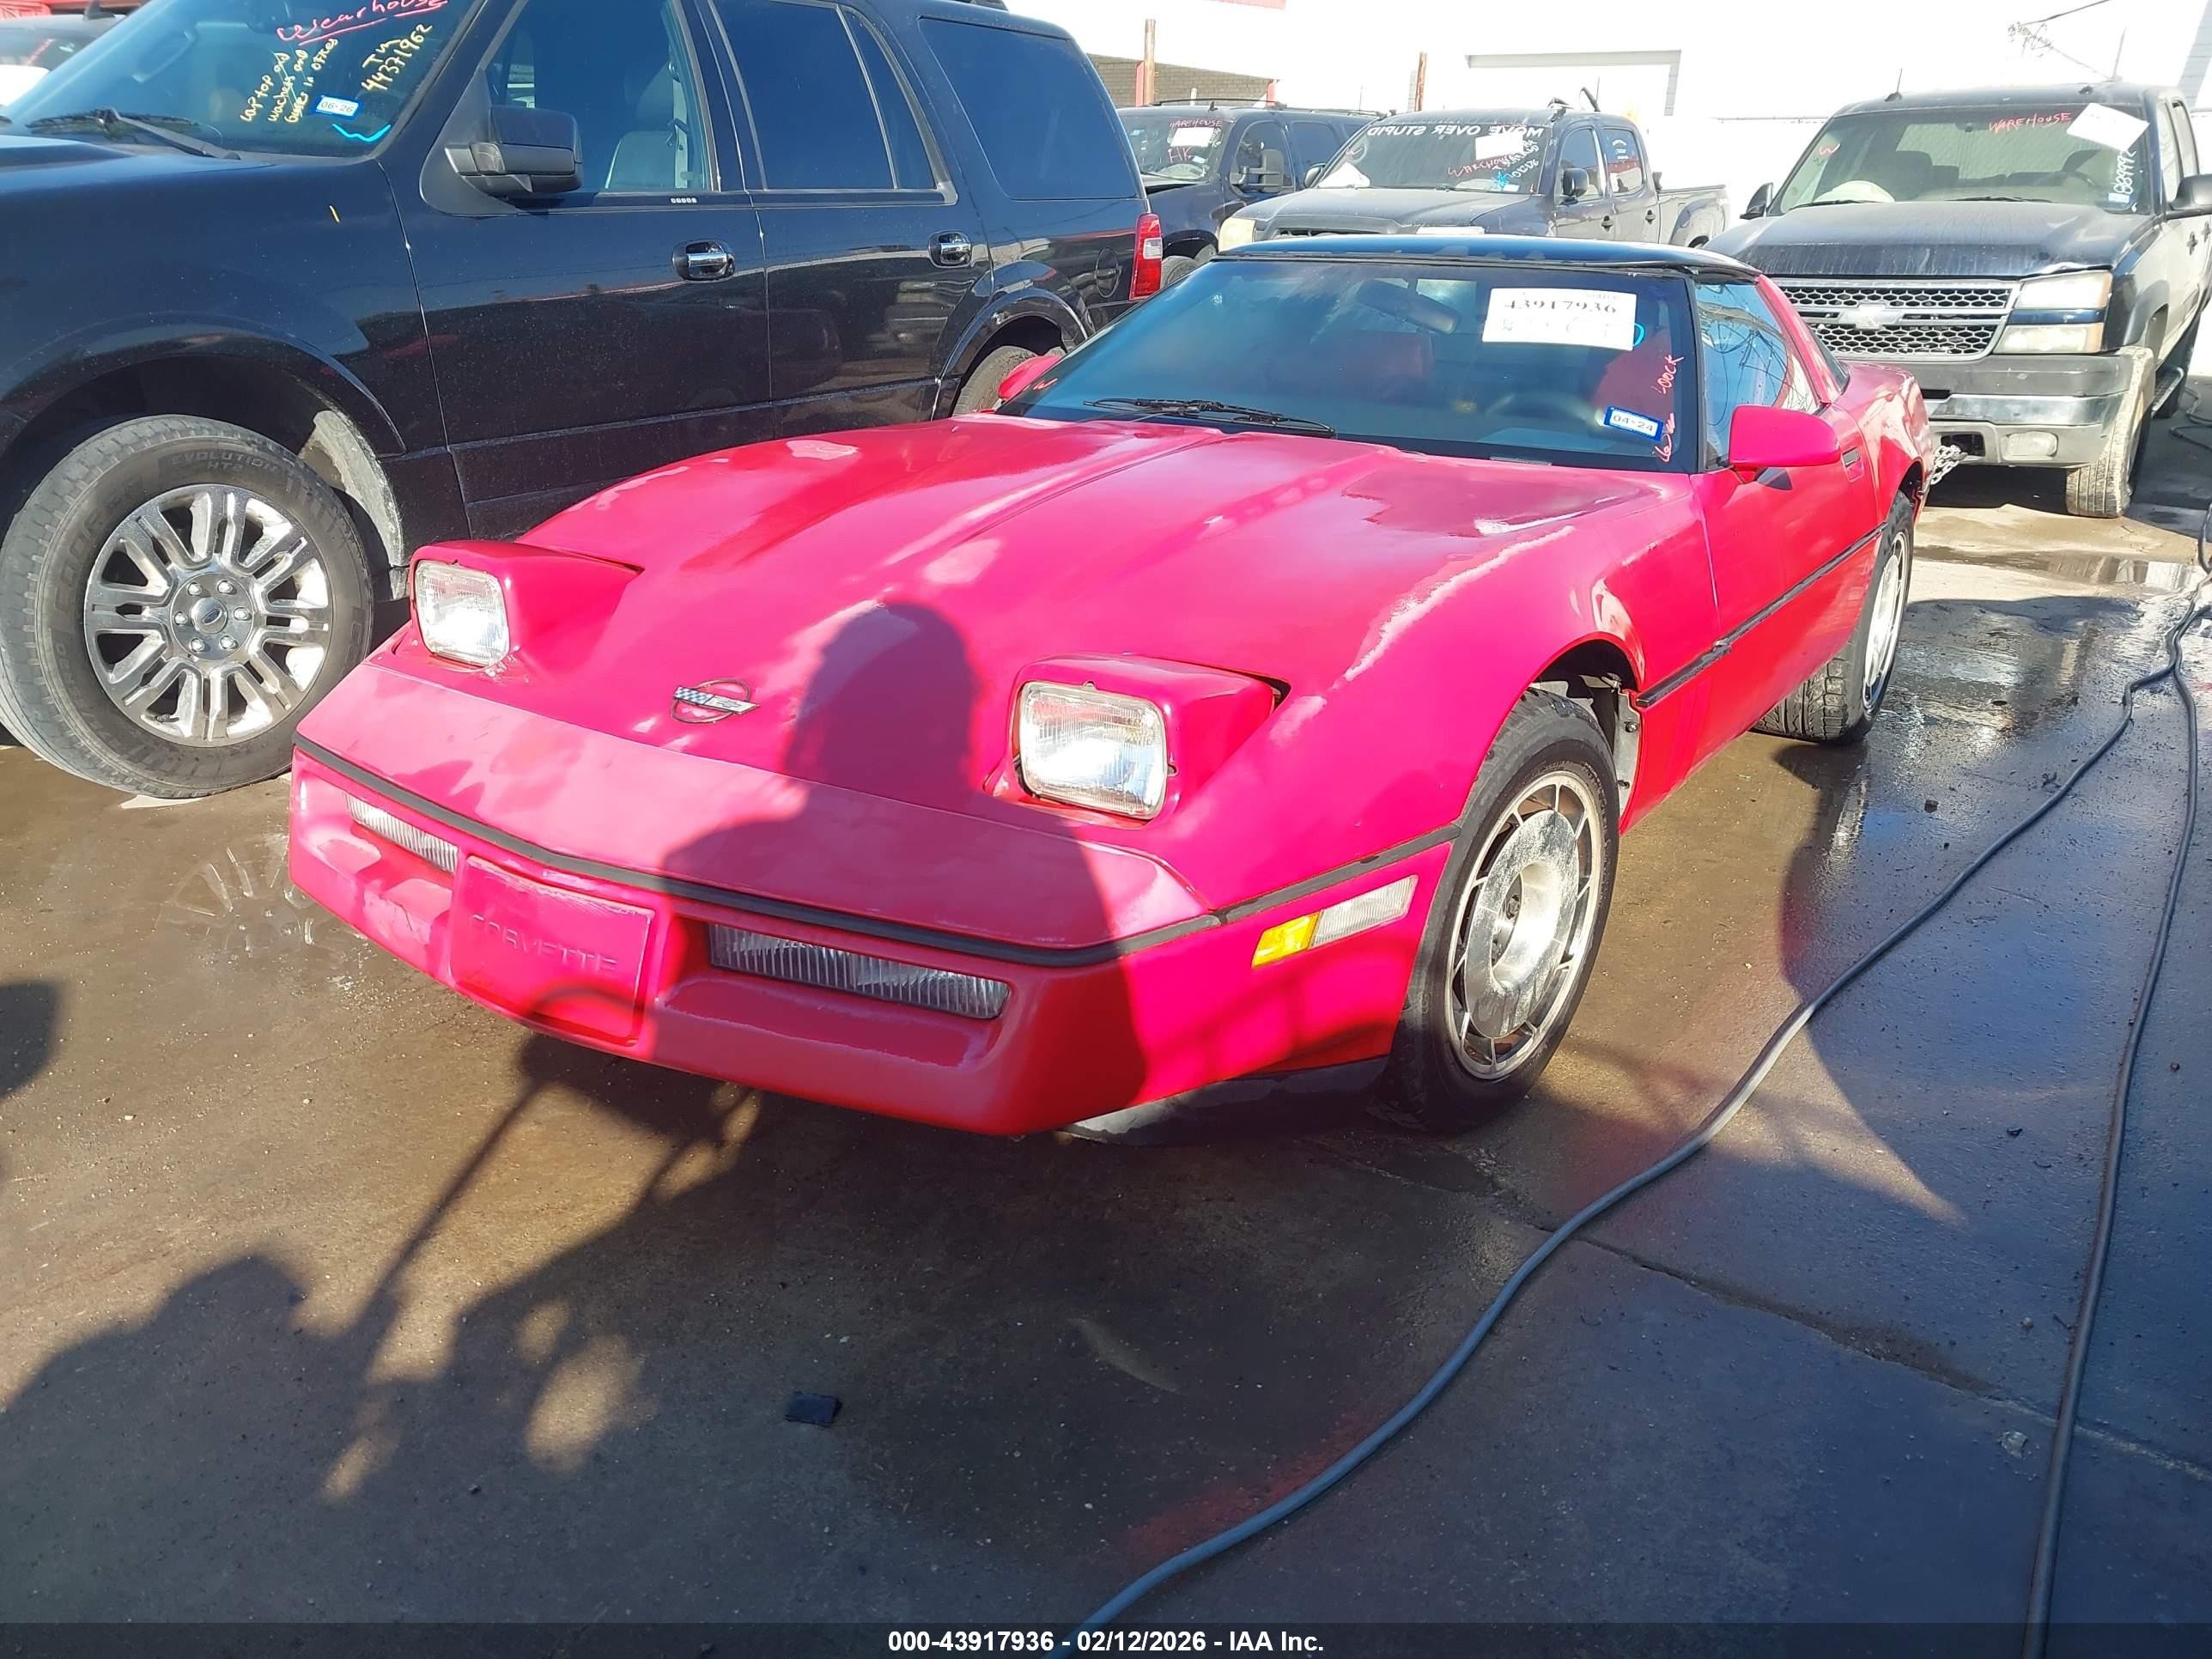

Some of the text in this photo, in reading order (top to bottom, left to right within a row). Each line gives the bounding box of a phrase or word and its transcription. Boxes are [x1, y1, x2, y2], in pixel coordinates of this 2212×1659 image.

[362, 24, 433, 90] 44371962
[1989, 112, 2072, 133] WAREHOUSE
[470, 913, 618, 975] CORVETTE
